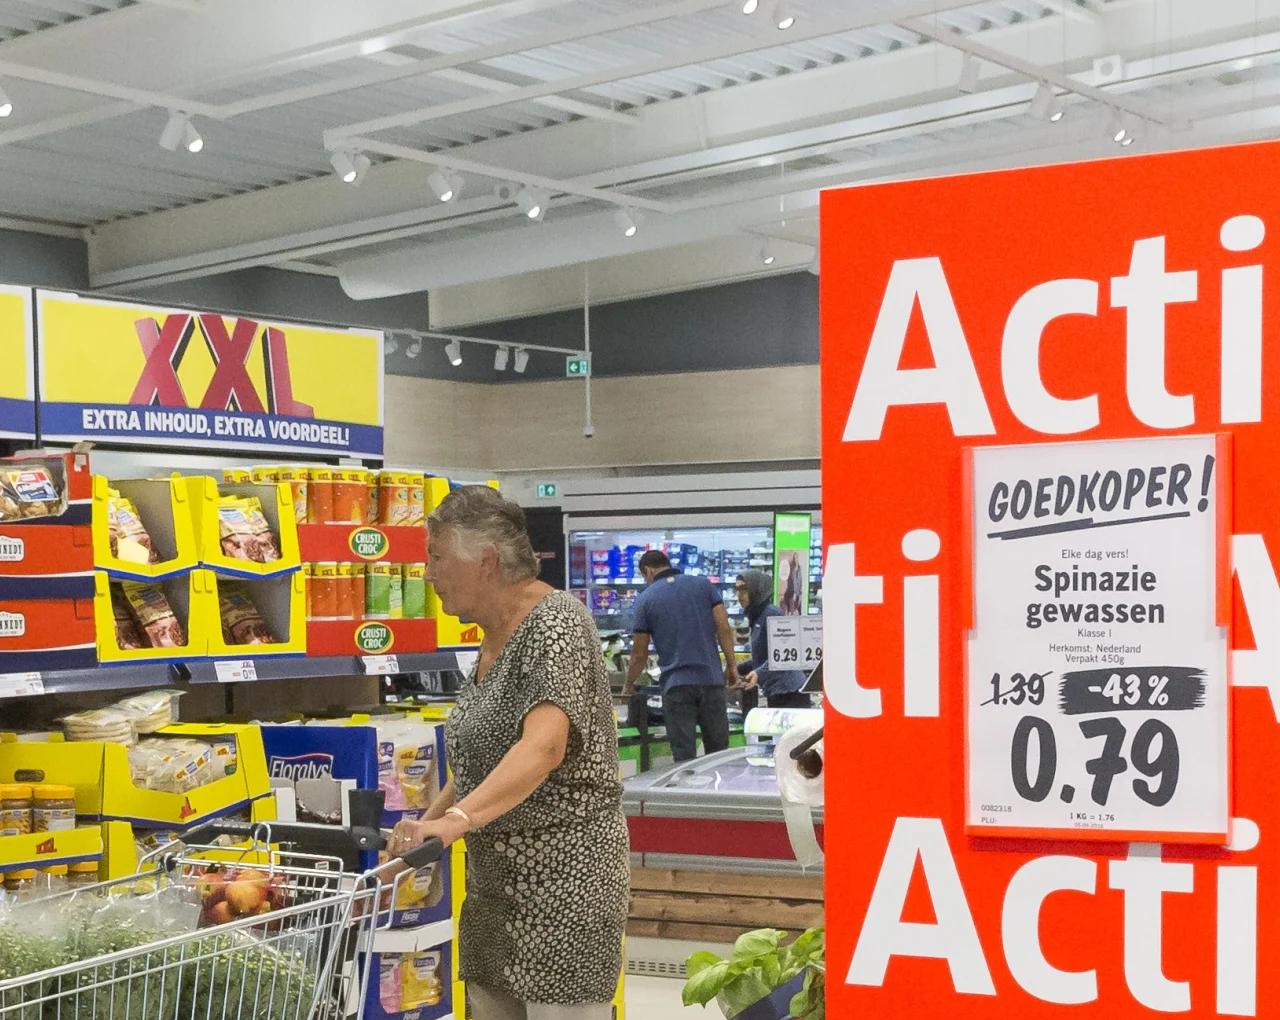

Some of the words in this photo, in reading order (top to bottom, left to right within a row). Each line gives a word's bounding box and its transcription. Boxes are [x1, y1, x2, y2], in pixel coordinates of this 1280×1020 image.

[128, 314, 315, 417] XXL
[82, 409, 141, 431] EXTRA
[144, 412, 212, 437] INHOUD,
[214, 417, 265, 438] EXTRA
[269, 420, 350, 446] VOORDEEL!
[988, 454, 1215, 523] GOEDKOPER!
[355, 533, 381, 544] CRUSTI
[358, 544, 378, 555] CROC
[1061, 549, 1081, 559] Elke
[1085, 549, 1103, 561] dag
[1106, 549, 1129, 559] vers!
[1034, 564, 1157, 598] Spinazie
[1026, 603, 1165, 628] gewassen
[361, 628, 387, 639] CRUSTI
[460, 625, 481, 643] XXL
[1077, 628, 1106, 638] Klasse
[363, 639, 384, 650] CROC
[1049, 643, 1093, 653] Herkomst:
[1096, 644, 1141, 653] Nederland
[773, 647, 798, 663] 6.29
[1065, 654, 1099, 664] Verpakt
[1101, 654, 1125, 665] 450g
[988, 672, 1046, 705] 1.39
[1088, 674, 1140, 705] -43
[1148, 675, 1169, 705] %
[1011, 715, 1180, 807] 0.79
[981, 804, 1012, 813] 0082318
[981, 816, 997, 824] PLU:
[36, 838, 57, 854] XXL
